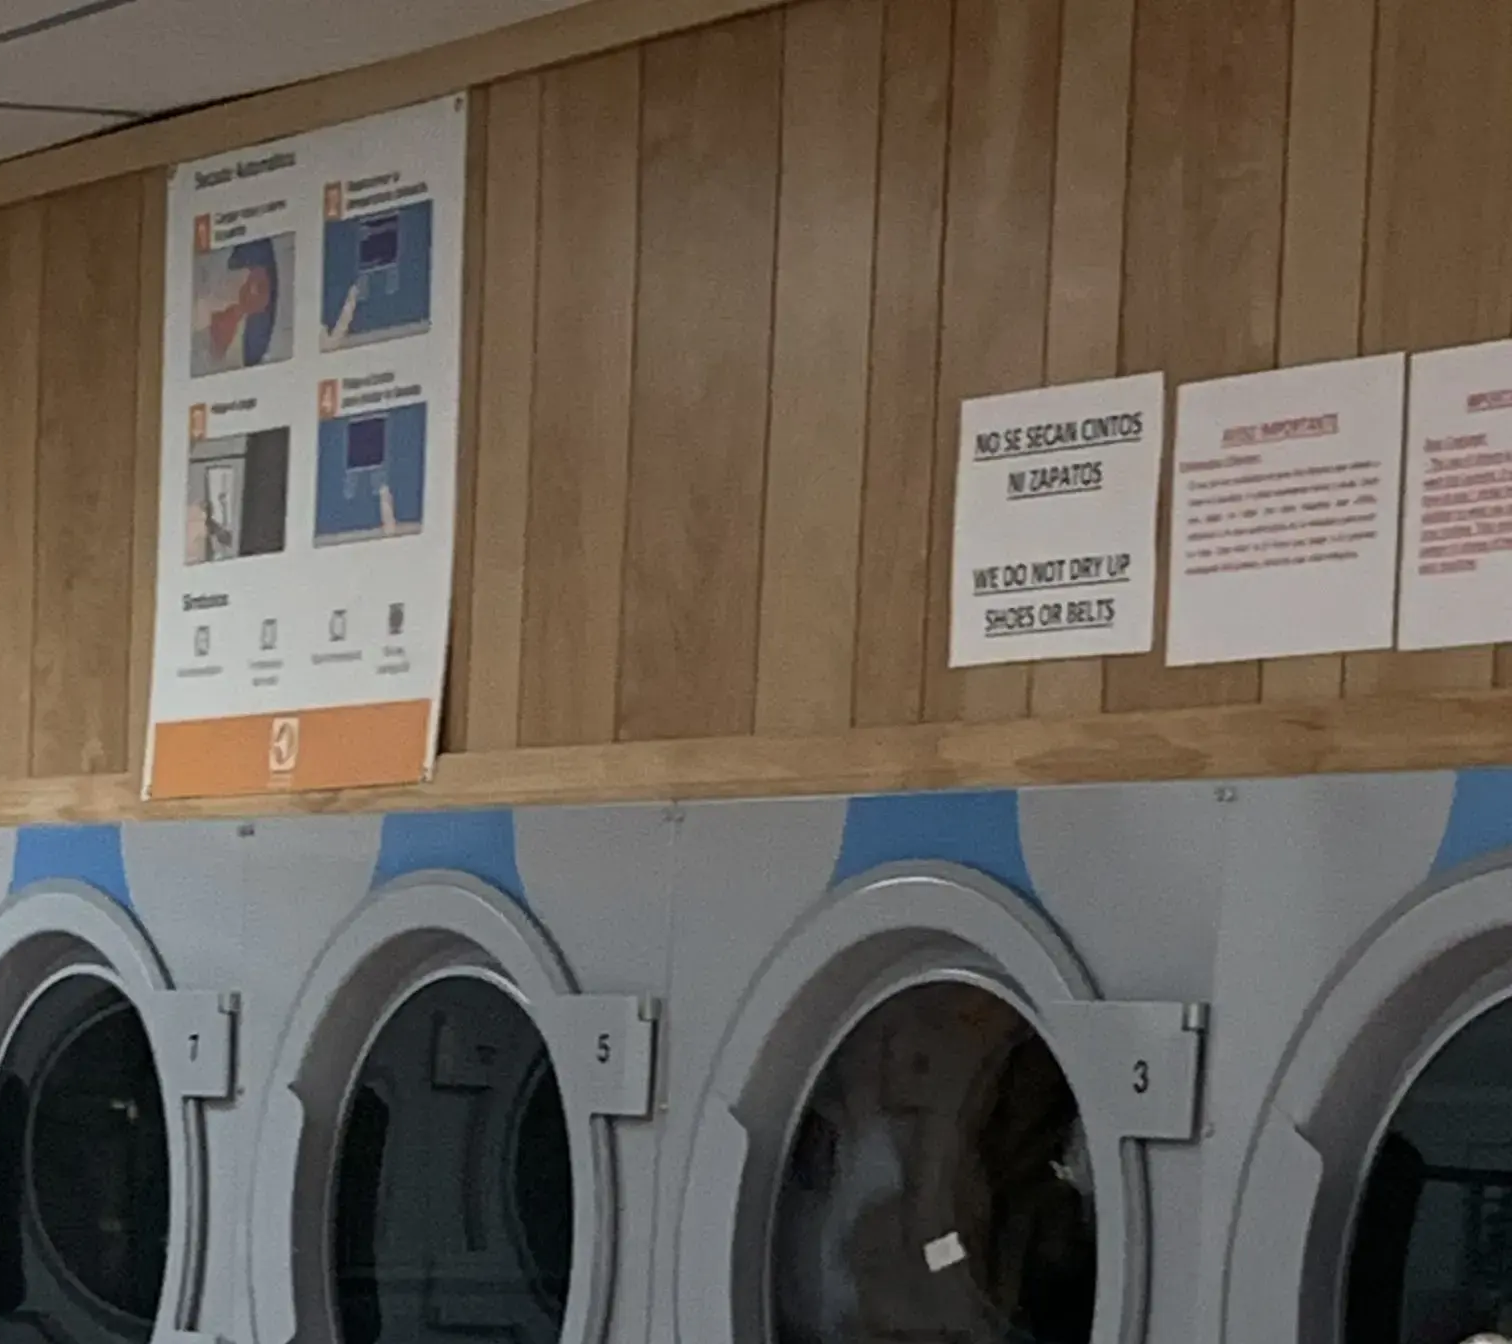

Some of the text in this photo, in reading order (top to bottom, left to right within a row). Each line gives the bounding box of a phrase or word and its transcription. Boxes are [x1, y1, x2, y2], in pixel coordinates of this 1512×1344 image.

[975, 411, 1144, 455] NO SE SECAN CINTOS
[1007, 460, 1104, 494] NI ZAPATOS
[973, 552, 1131, 589] WE DO NOT DRY UP
[985, 597, 1116, 632] SHOES OR BELTS
[596, 1033, 611, 1065] 5
[1132, 1059, 1149, 1094] 3
